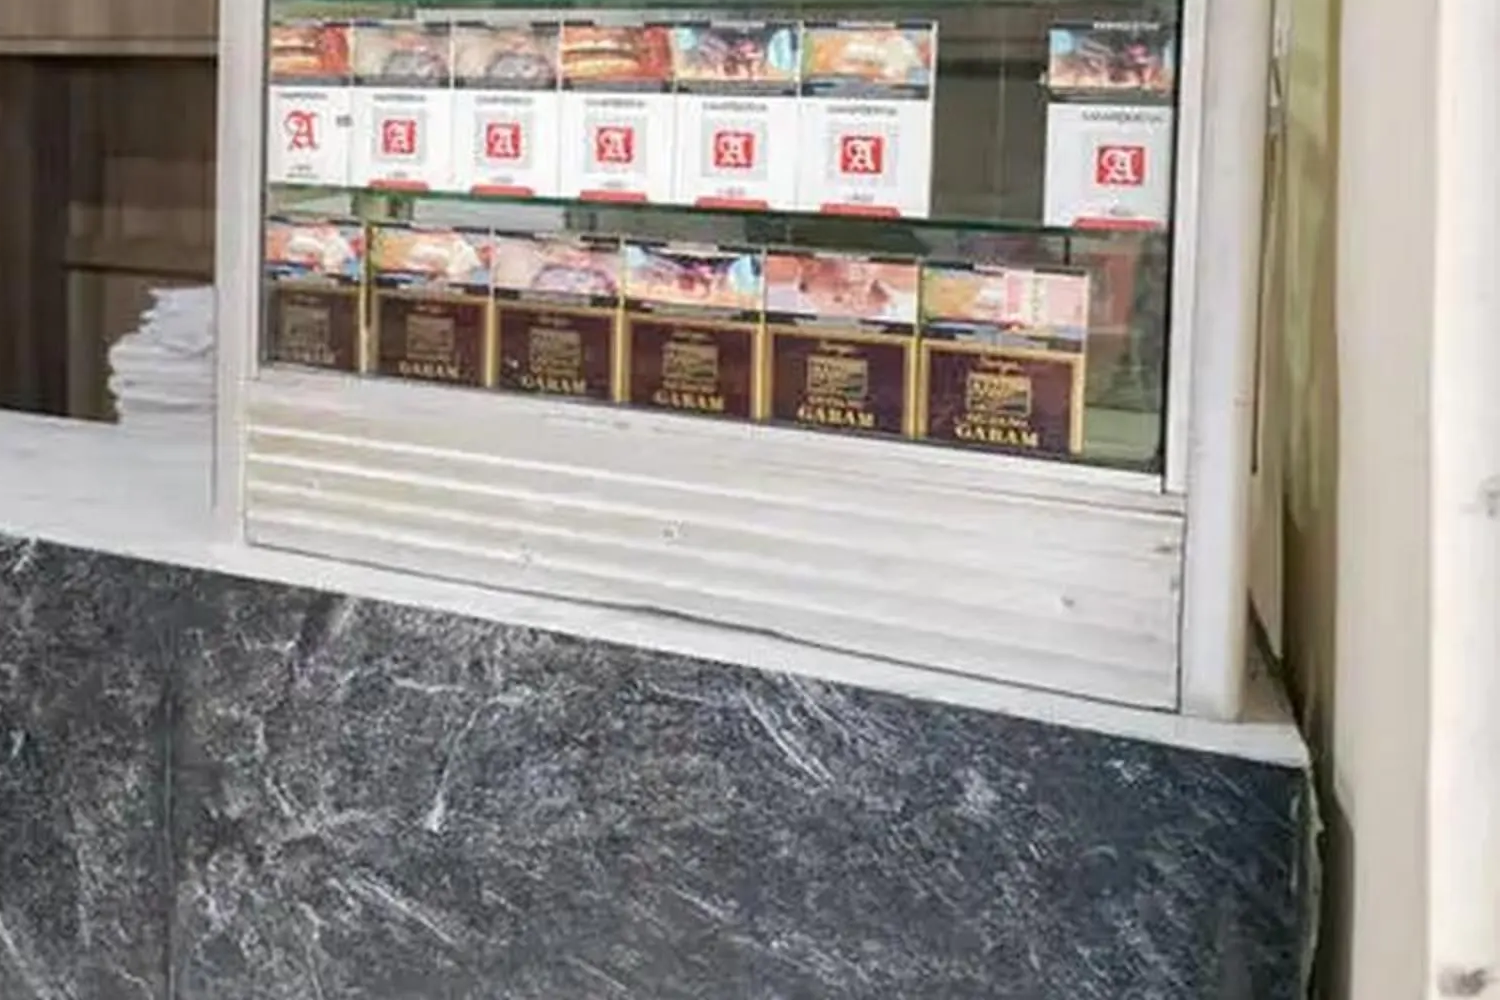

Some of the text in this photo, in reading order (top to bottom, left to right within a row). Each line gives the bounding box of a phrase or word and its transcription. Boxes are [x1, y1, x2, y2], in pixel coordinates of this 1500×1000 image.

[283, 110, 320, 152] A
[1101, 147, 1140, 184] A
[797, 406, 875, 428] GARAM
[954, 424, 1039, 447] GARAM
